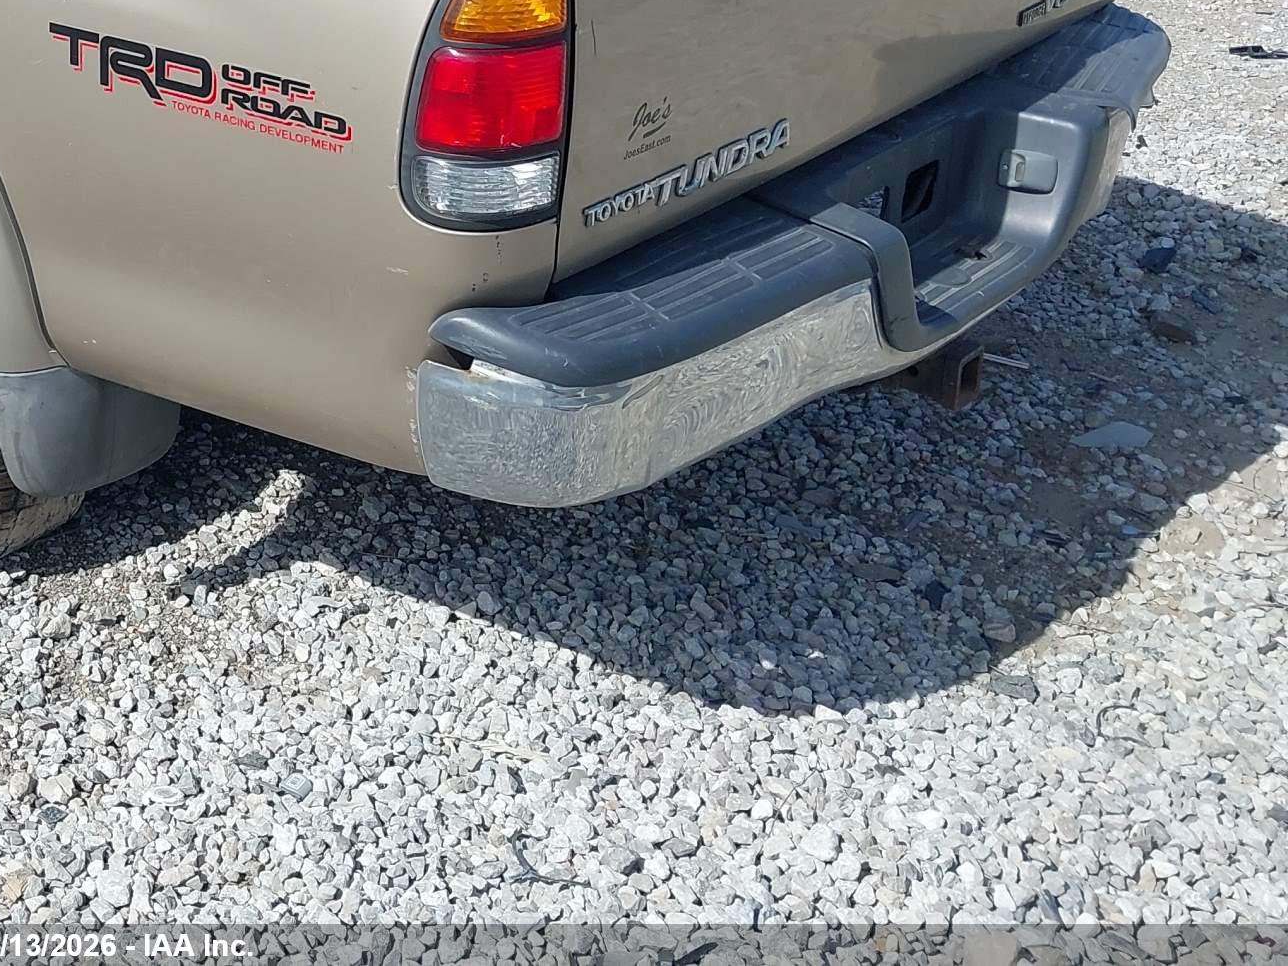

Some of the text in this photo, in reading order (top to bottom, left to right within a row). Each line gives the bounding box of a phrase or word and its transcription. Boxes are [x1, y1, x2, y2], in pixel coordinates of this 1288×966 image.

[49, 21, 217, 107] TRD
[221, 64, 315, 102] OFF
[171, 100, 345, 154] TOYOTA RACING DEVELOPMENT
[221, 89, 352, 142] ROAD
[628, 96, 672, 141] Joe's
[582, 118, 791, 227] TOYOTA TUNDRA
